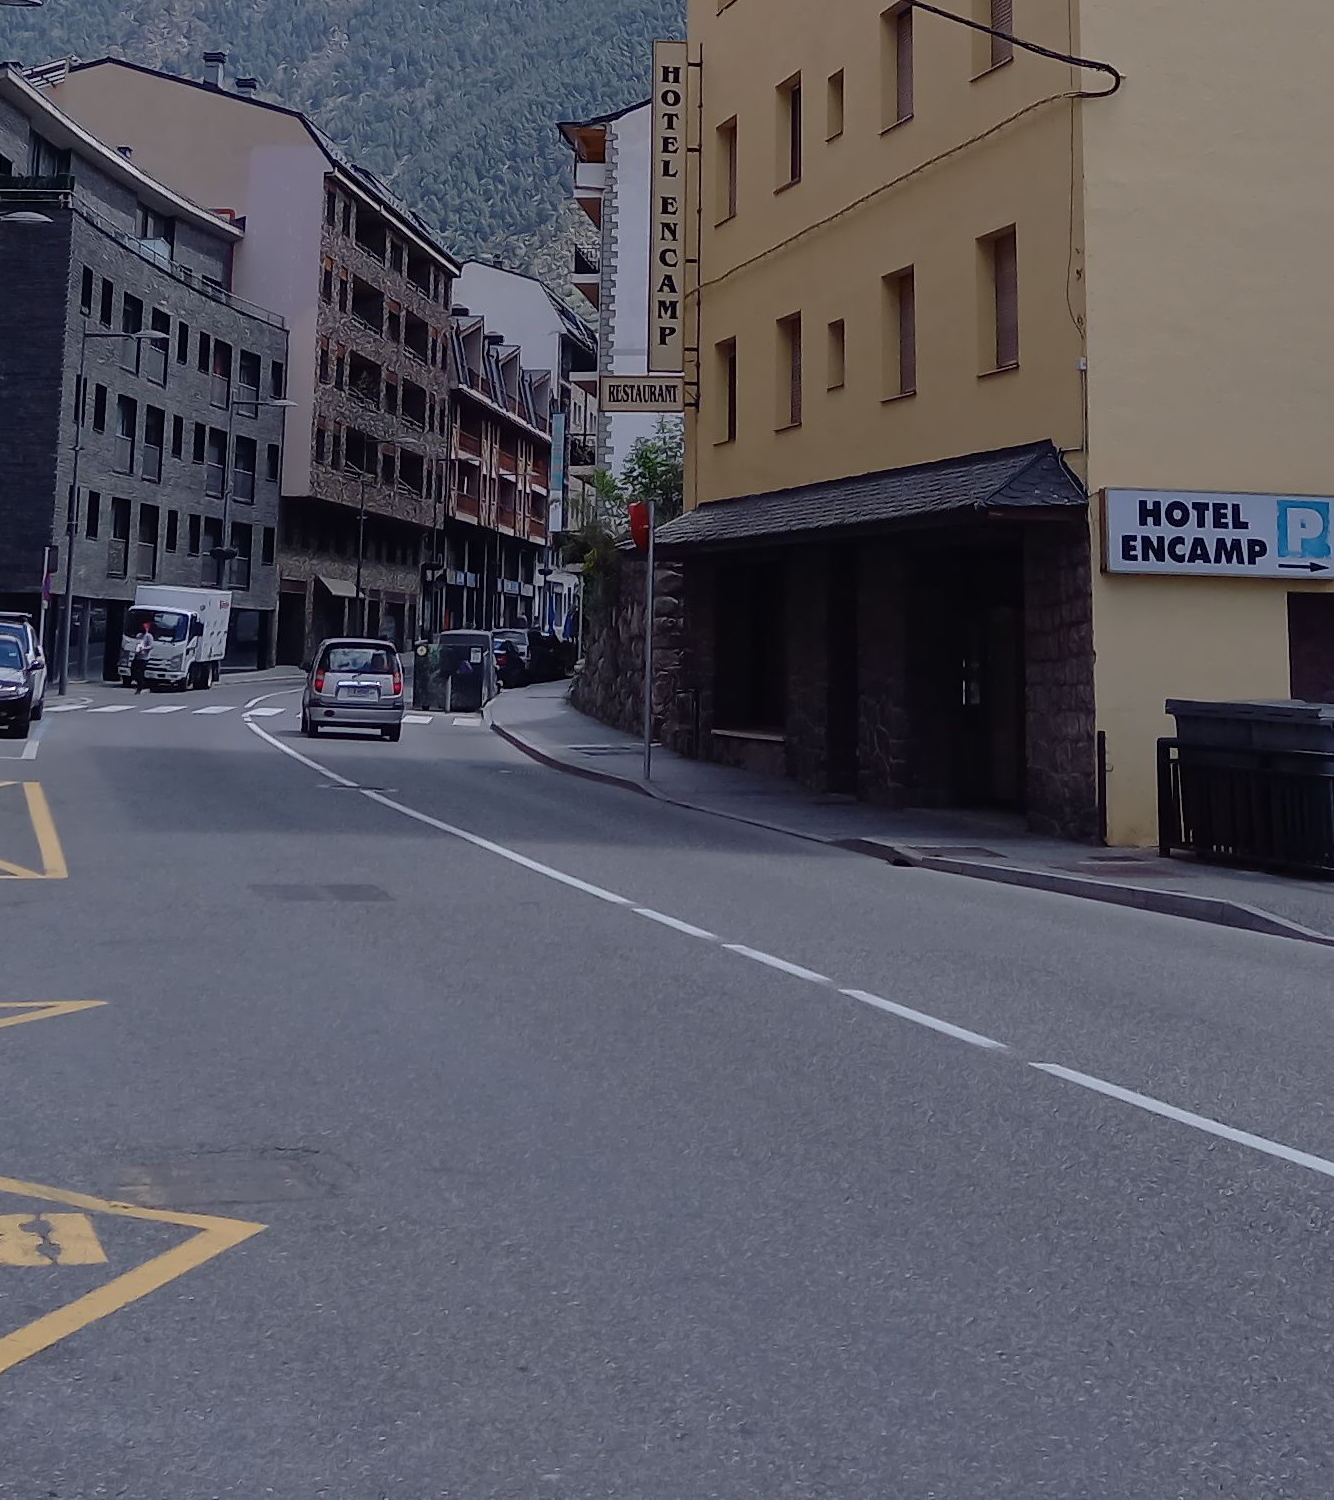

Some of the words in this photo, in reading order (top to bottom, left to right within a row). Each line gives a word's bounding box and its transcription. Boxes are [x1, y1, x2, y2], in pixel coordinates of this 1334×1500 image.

[661, 65, 681, 178] HOTEL
[657, 196, 679, 346] ENCAMP
[608, 384, 678, 403] RESTAURANT
[1138, 499, 1249, 529] HOTEL
[1121, 534, 1268, 566] ENCAMP
